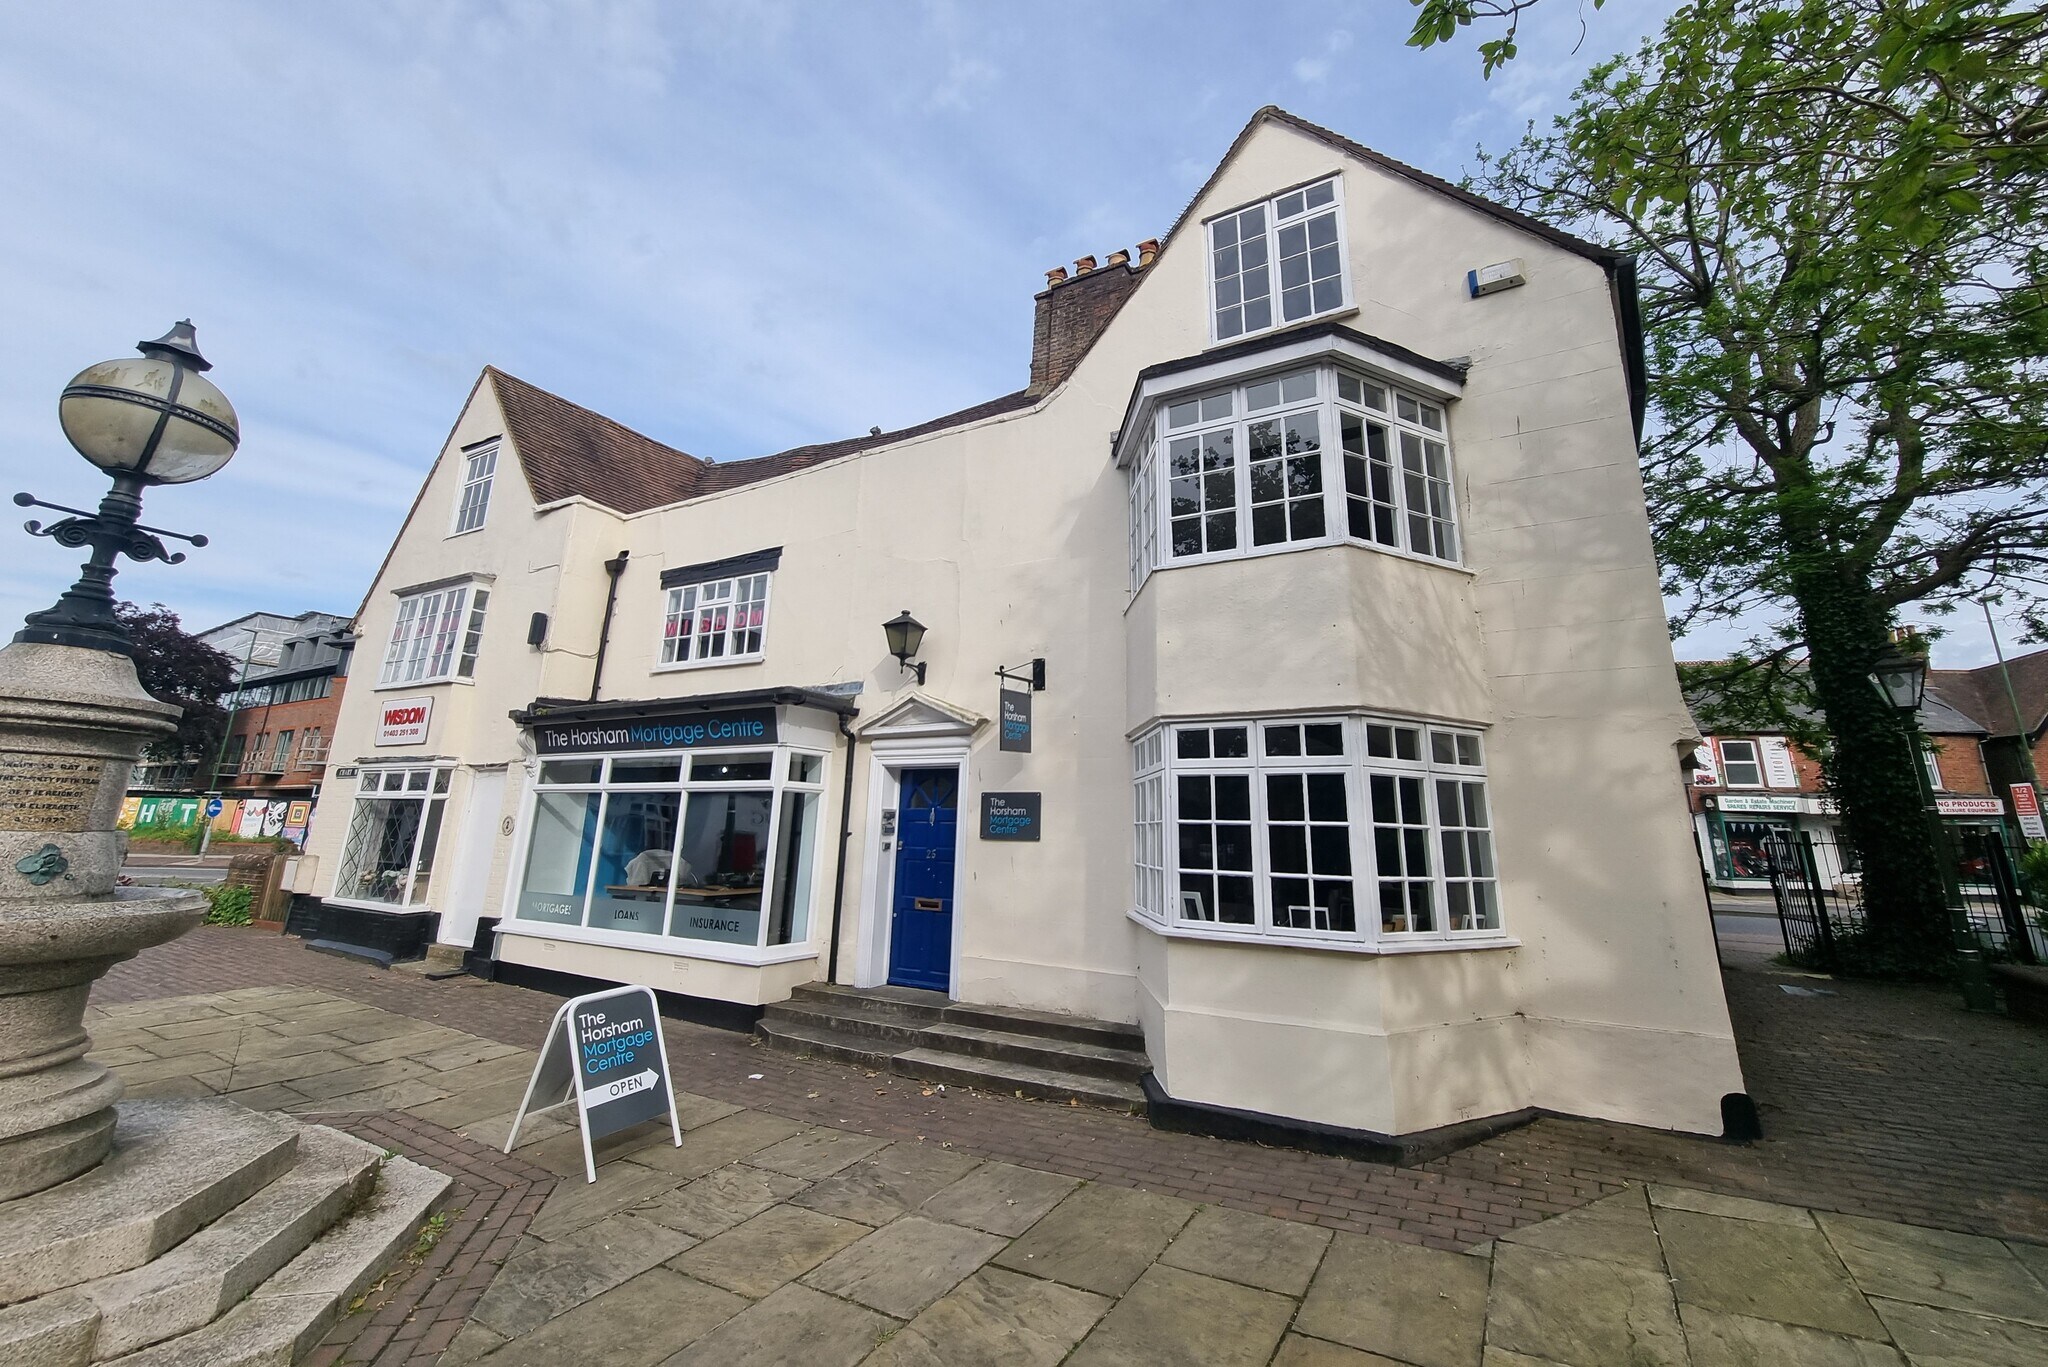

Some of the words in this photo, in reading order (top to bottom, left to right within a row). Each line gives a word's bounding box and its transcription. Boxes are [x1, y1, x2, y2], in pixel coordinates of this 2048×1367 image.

[665, 610, 763, 639] WISDOM
[1004, 701, 1015, 711] The
[384, 706, 427, 727] WISDOM
[1004, 710, 1027, 722] Horsham
[545, 730, 568, 747] The
[571, 726, 630, 746] Horsham
[631, 722, 705, 746] Mortgage
[708, 717, 764, 740] Centre
[1004, 720, 1030, 733] Mortgage
[1004, 730, 1022, 740] Centre
[990, 797, 1006, 806] The
[990, 806, 1027, 816] Horsham
[990, 815, 1032, 827] Mortgage
[990, 824, 1018, 834] Centre
[613, 909, 640, 921] LOANS
[689, 916, 740, 933] INSURANCE
[578, 1012, 606, 1029] The
[581, 1018, 644, 1044] Horsham
[583, 1030, 653, 1059] Mortgage
[586, 1051, 635, 1074] Centre
[609, 1076, 643, 1096] OPEN
